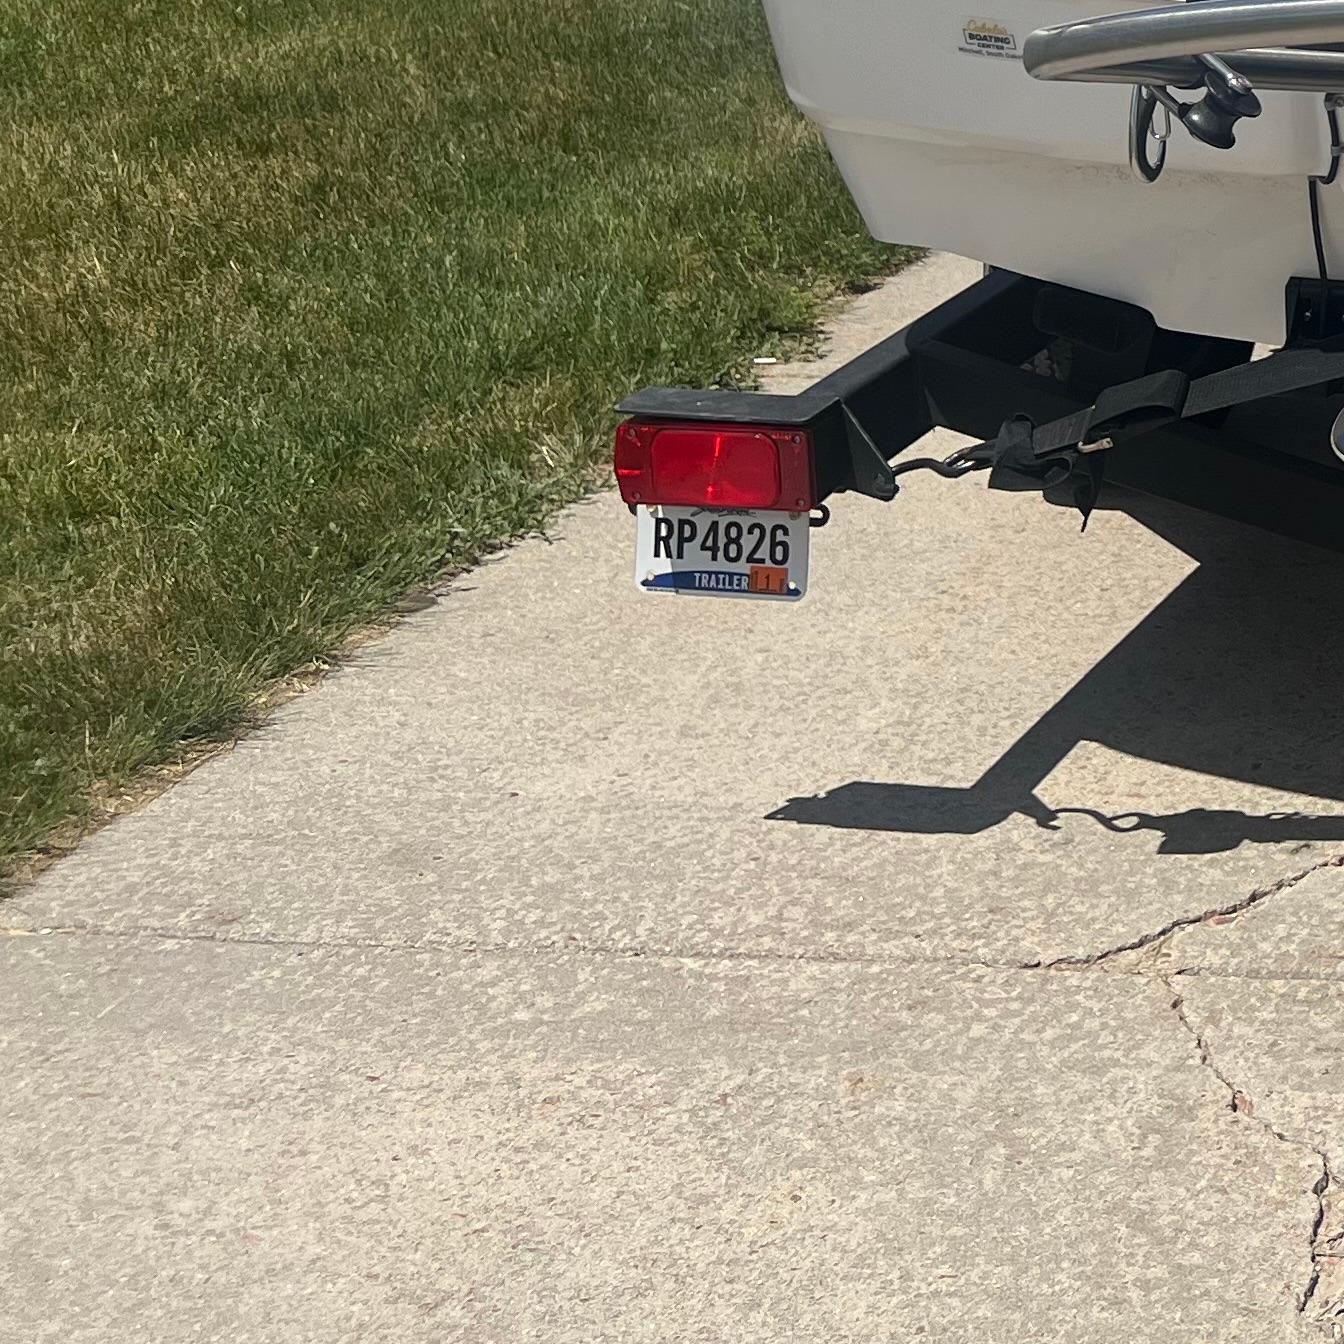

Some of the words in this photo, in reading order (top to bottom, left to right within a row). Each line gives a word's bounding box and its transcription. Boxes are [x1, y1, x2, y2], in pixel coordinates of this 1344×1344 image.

[967, 32, 1011, 45] BOATING
[653, 517, 790, 566] RP4826
[693, 572, 749, 591] TRAILER
